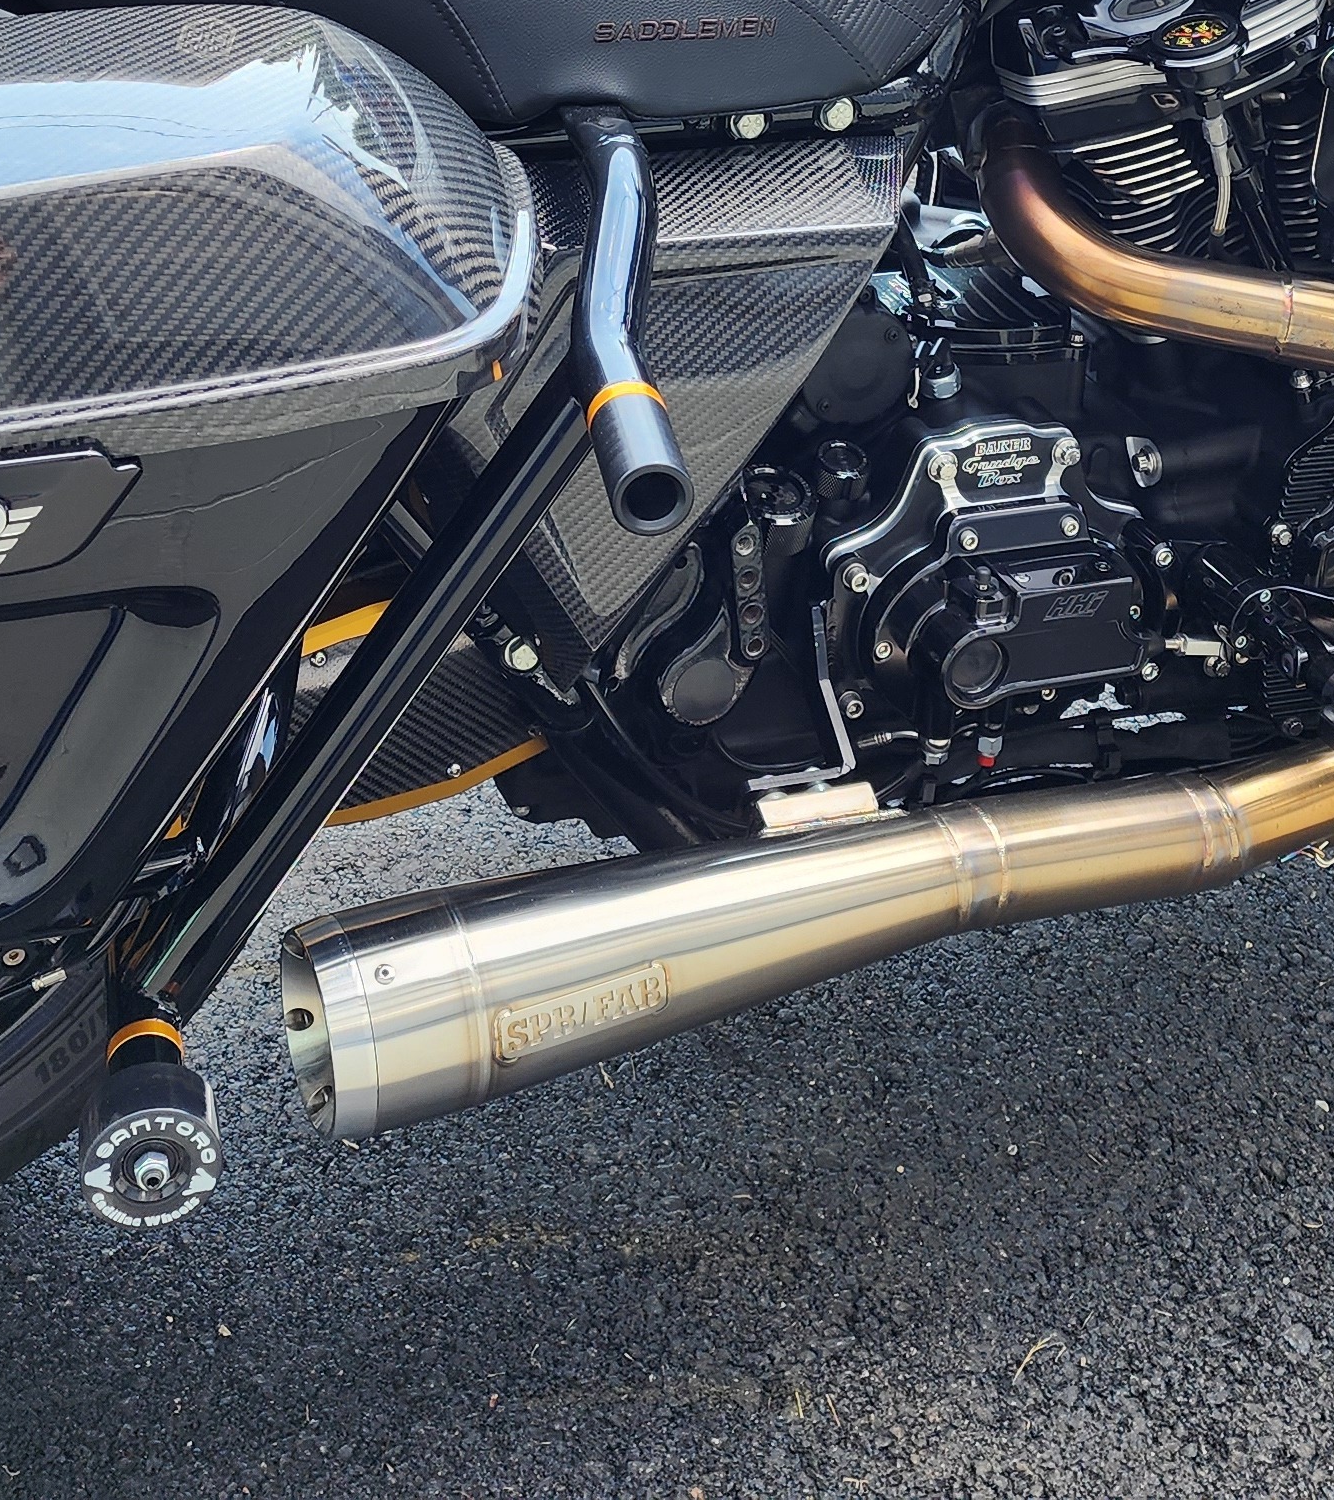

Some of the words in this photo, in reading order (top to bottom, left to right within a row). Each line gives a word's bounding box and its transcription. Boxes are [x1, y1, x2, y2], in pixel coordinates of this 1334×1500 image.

[594, 16, 777, 43] SADDLEMEN
[974, 437, 1032, 457] BAKER
[961, 454, 1041, 474] Grudge
[976, 470, 1023, 488] Box
[95, 1116, 218, 1165] SANTORO
[144, 1196, 201, 1228] Wheels
